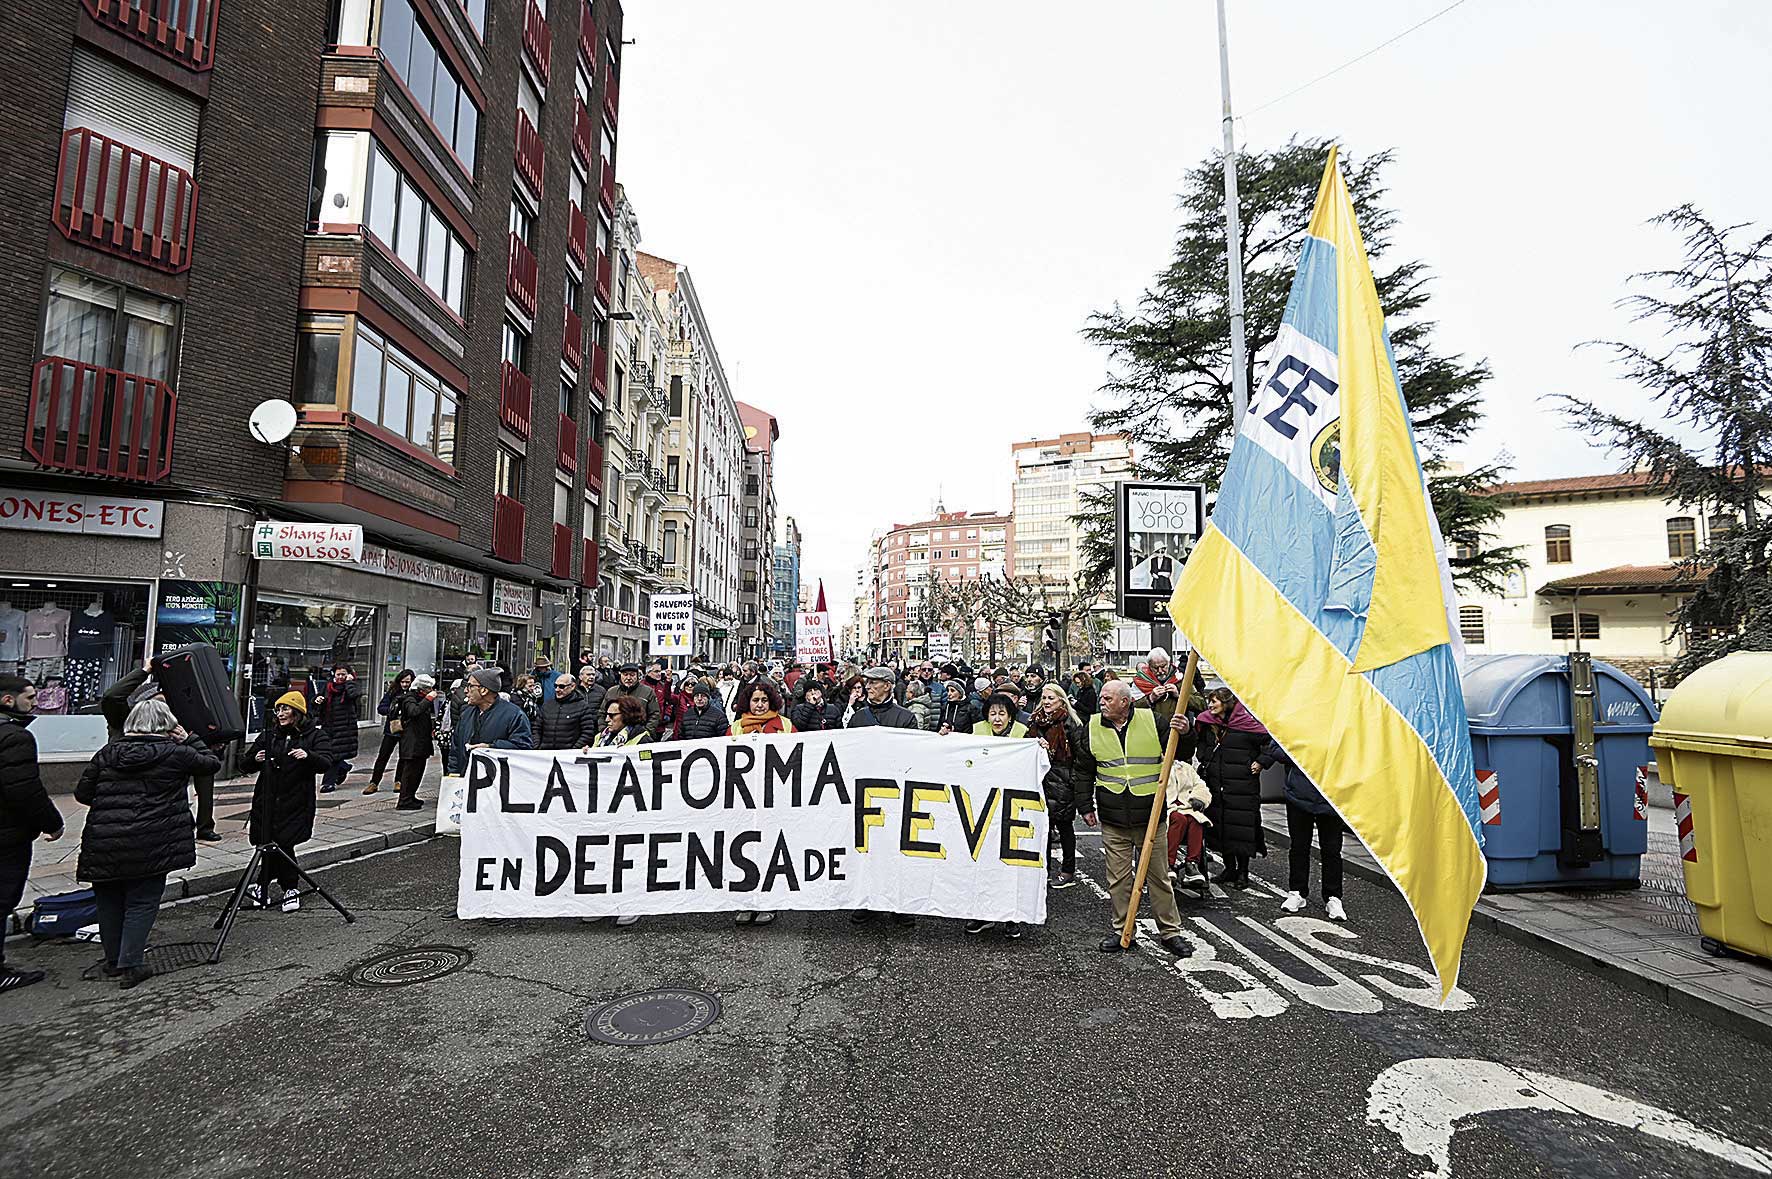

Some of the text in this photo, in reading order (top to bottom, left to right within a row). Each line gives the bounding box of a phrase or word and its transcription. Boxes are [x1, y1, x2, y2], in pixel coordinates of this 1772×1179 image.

[1138, 492, 1187, 519] yoko
[0, 497, 155, 529] ONES-ETC.
[1143, 514, 1183, 529] ono
[279, 526, 353, 544] Shang hai
[280, 545, 351, 559] BOLSOS
[361, 549, 481, 590] APATOS-JOYAS-CINTURONES-ETC.
[165, 595, 181, 603] ZERO
[653, 600, 692, 608] SALVEMOS
[503, 601, 531, 617] BOLSOS
[656, 612, 690, 620] NUESTRO
[653, 623, 686, 631] TREN DE
[805, 615, 820, 626] NO
[657, 634, 689, 646] FEVE
[810, 636, 825, 647] 15,4
[798, 646, 828, 655] MILLONES
[466, 741, 851, 814] PLATAFORMA
[475, 778, 1045, 897] EN DEFENSA DE FEVE
[1135, 916, 1478, 1019] BUS
